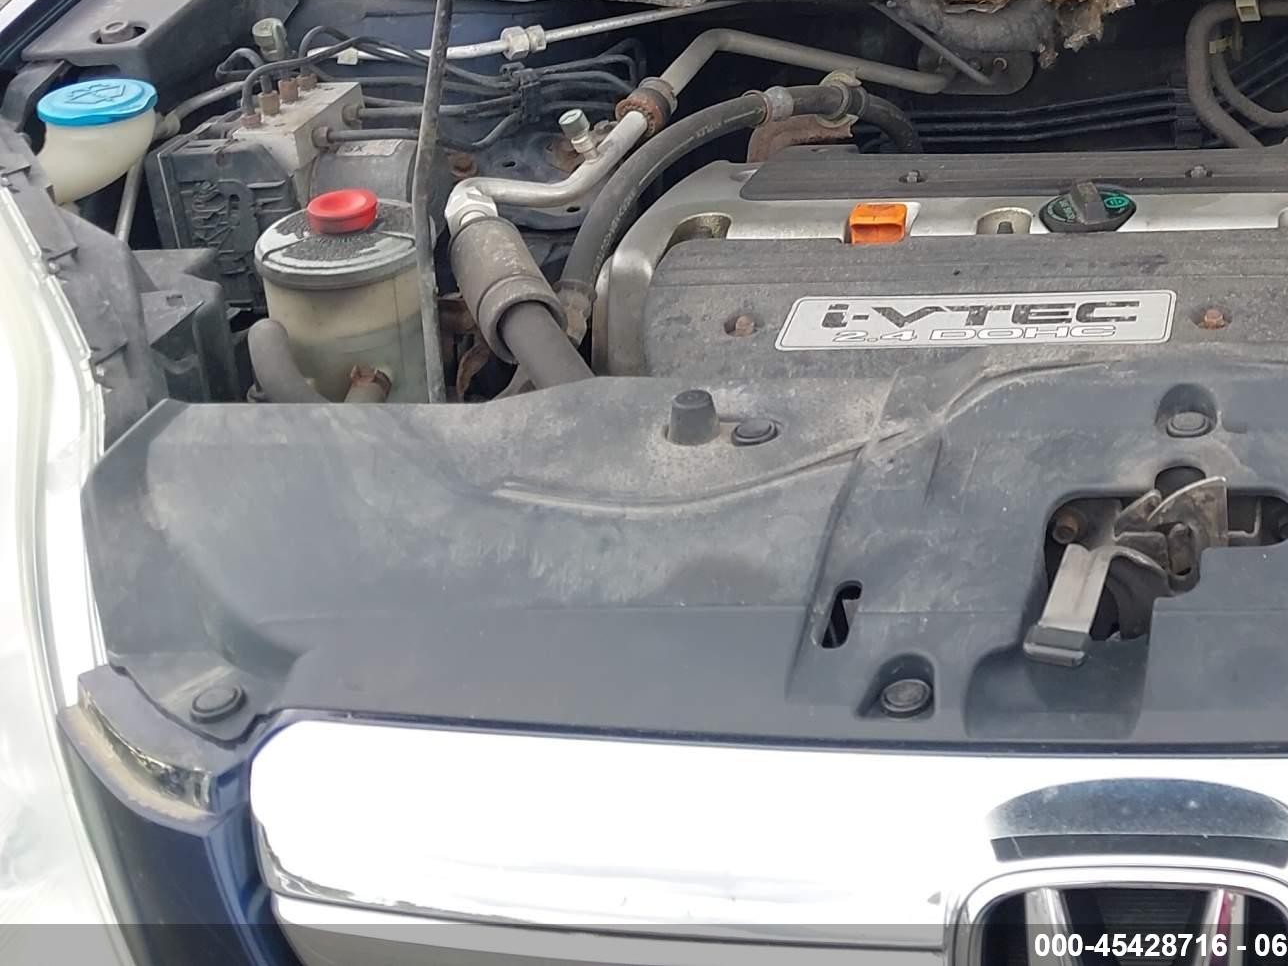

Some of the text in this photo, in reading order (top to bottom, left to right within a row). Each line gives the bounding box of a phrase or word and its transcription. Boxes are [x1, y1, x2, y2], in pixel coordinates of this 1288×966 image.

[822, 301, 1140, 328] i-VTEC
[832, 325, 1116, 342] 2.4 DOHC
